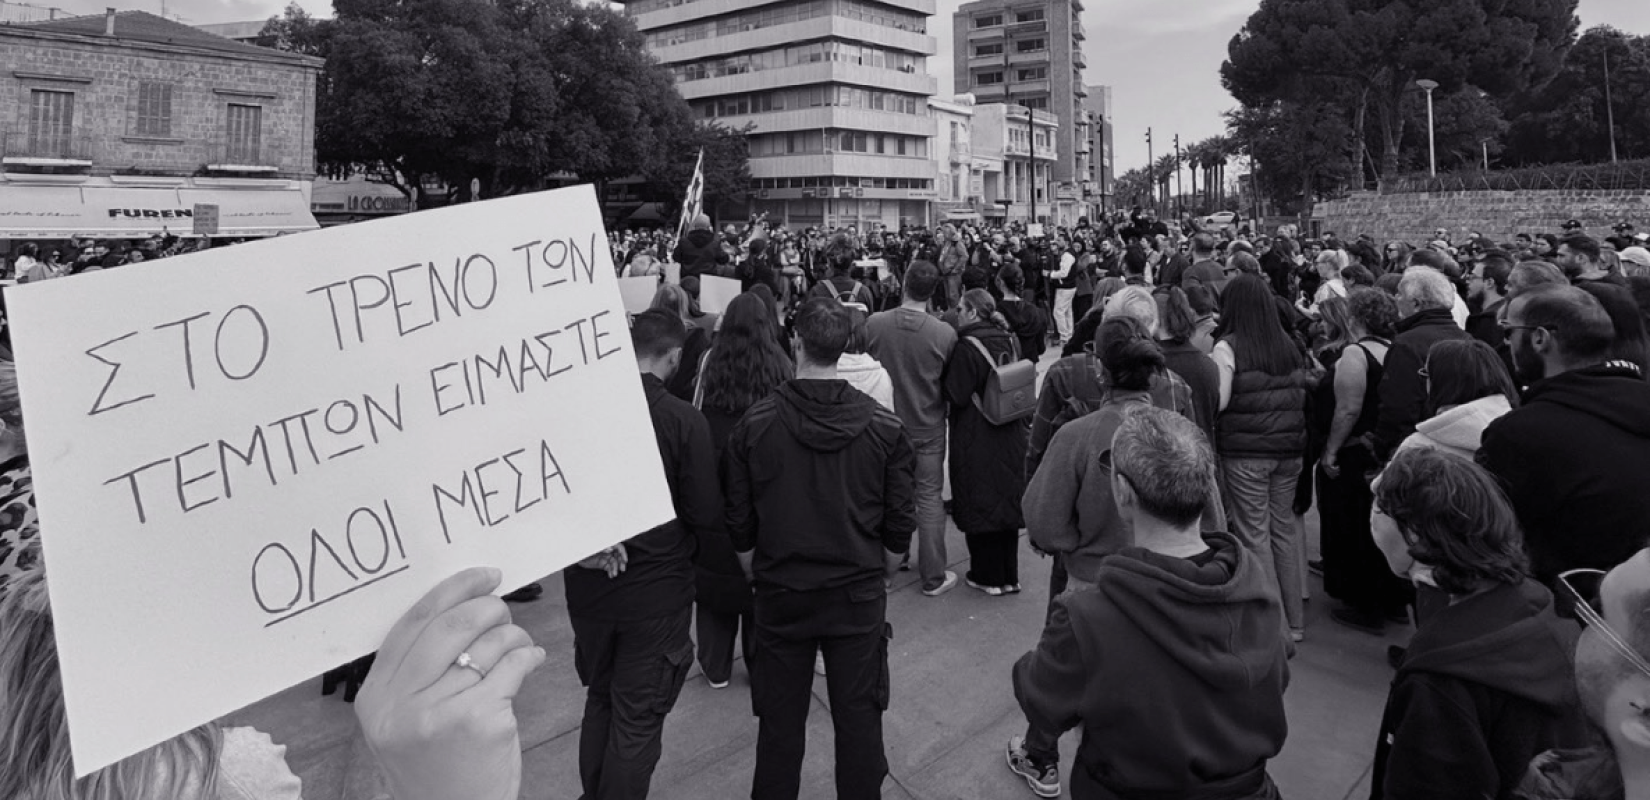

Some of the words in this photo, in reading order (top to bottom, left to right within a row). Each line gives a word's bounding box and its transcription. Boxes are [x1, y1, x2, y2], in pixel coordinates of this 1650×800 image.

[85, 305, 270, 415] ΣΤΟ
[307, 253, 498, 350] ΤΡΕΝΟ
[512, 233, 596, 293] ΤΩΝ
[103, 383, 404, 524] ΤΕΜΠΩΝ
[430, 310, 622, 416] ΕΙΜΑΣΤΕ
[252, 499, 409, 620] ΟΛΟΙ
[432, 440, 571, 544] ΜΕΣΑ
